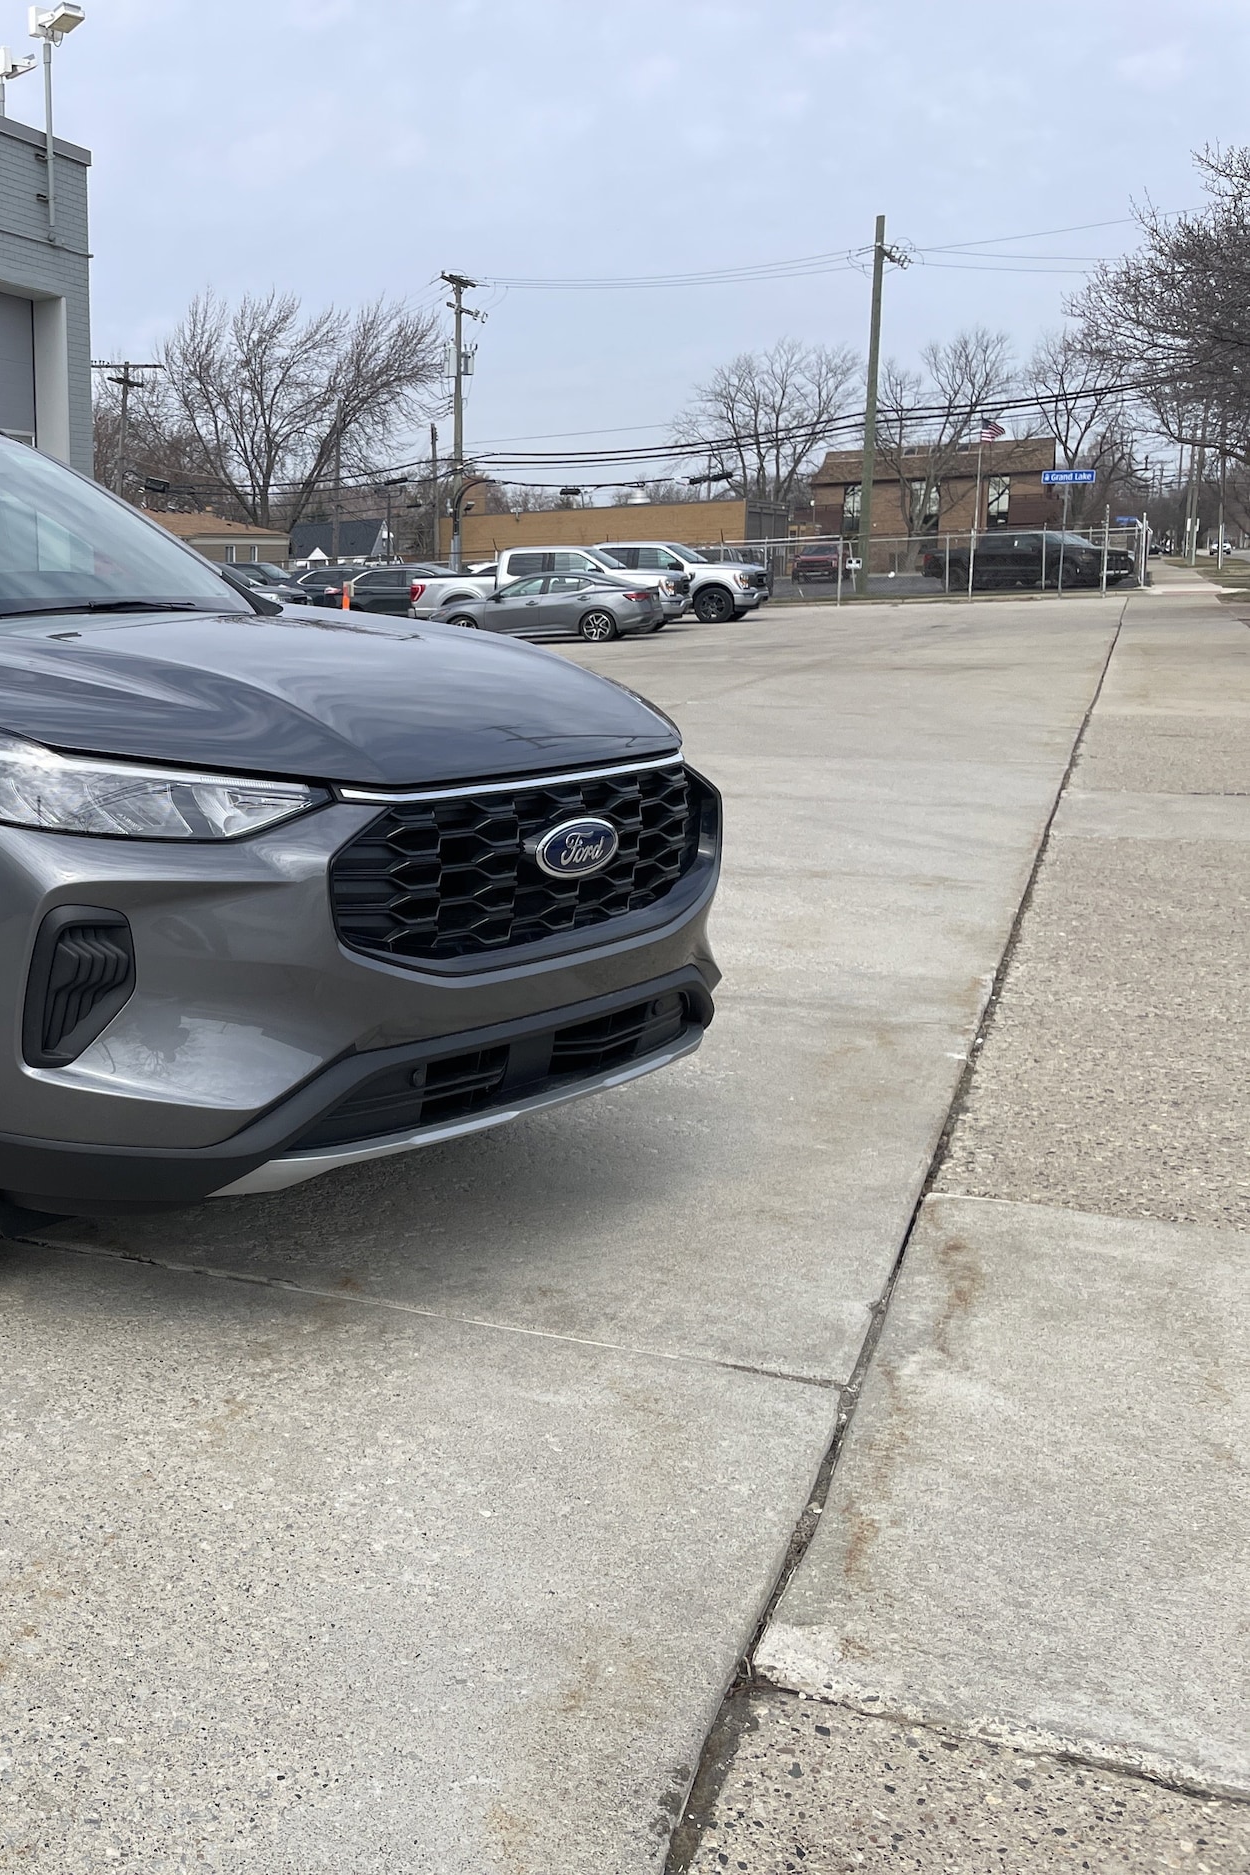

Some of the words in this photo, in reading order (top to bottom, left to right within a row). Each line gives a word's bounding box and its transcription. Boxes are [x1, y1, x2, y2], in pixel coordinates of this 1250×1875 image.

[1051, 473, 1073, 481] Grand
[1074, 472, 1091, 480] Lake
[561, 830, 605, 866] Ford
